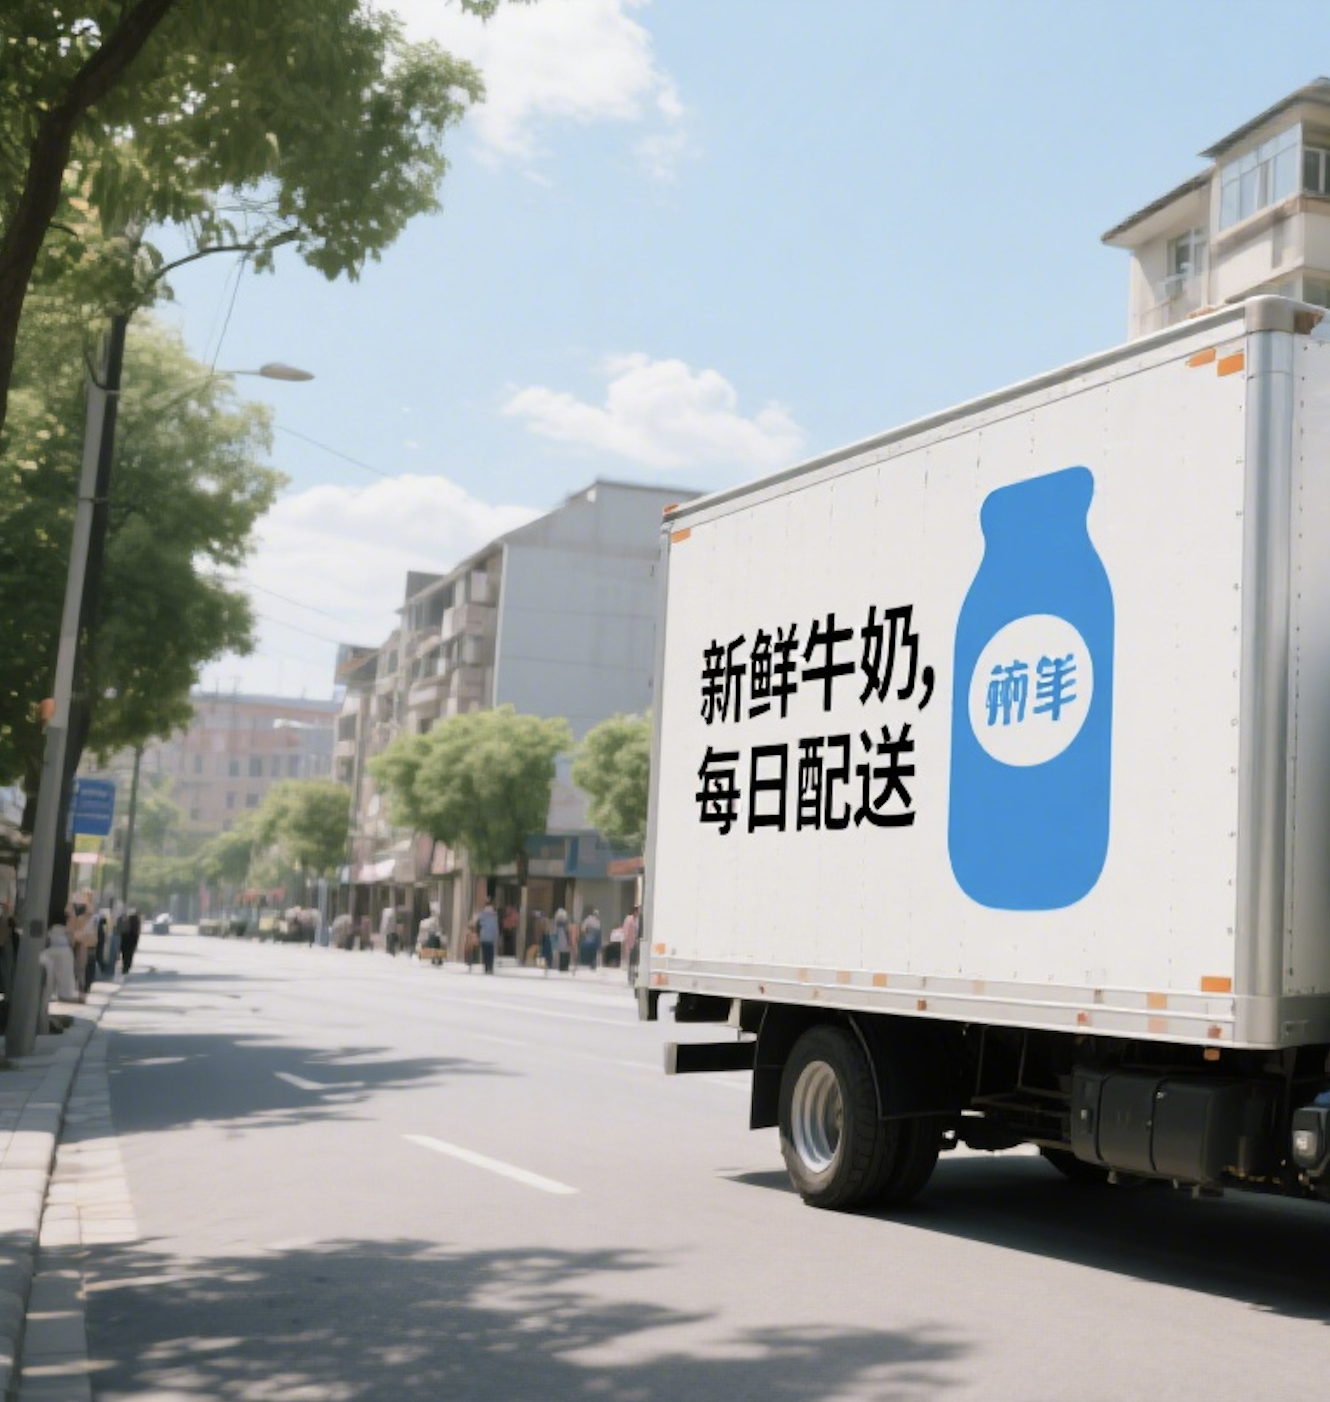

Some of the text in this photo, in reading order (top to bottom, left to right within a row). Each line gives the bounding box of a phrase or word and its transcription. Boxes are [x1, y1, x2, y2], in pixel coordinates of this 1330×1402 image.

[700, 604, 935, 726] 新鲜牛奶，
[695, 722, 916, 836] 每日配送
